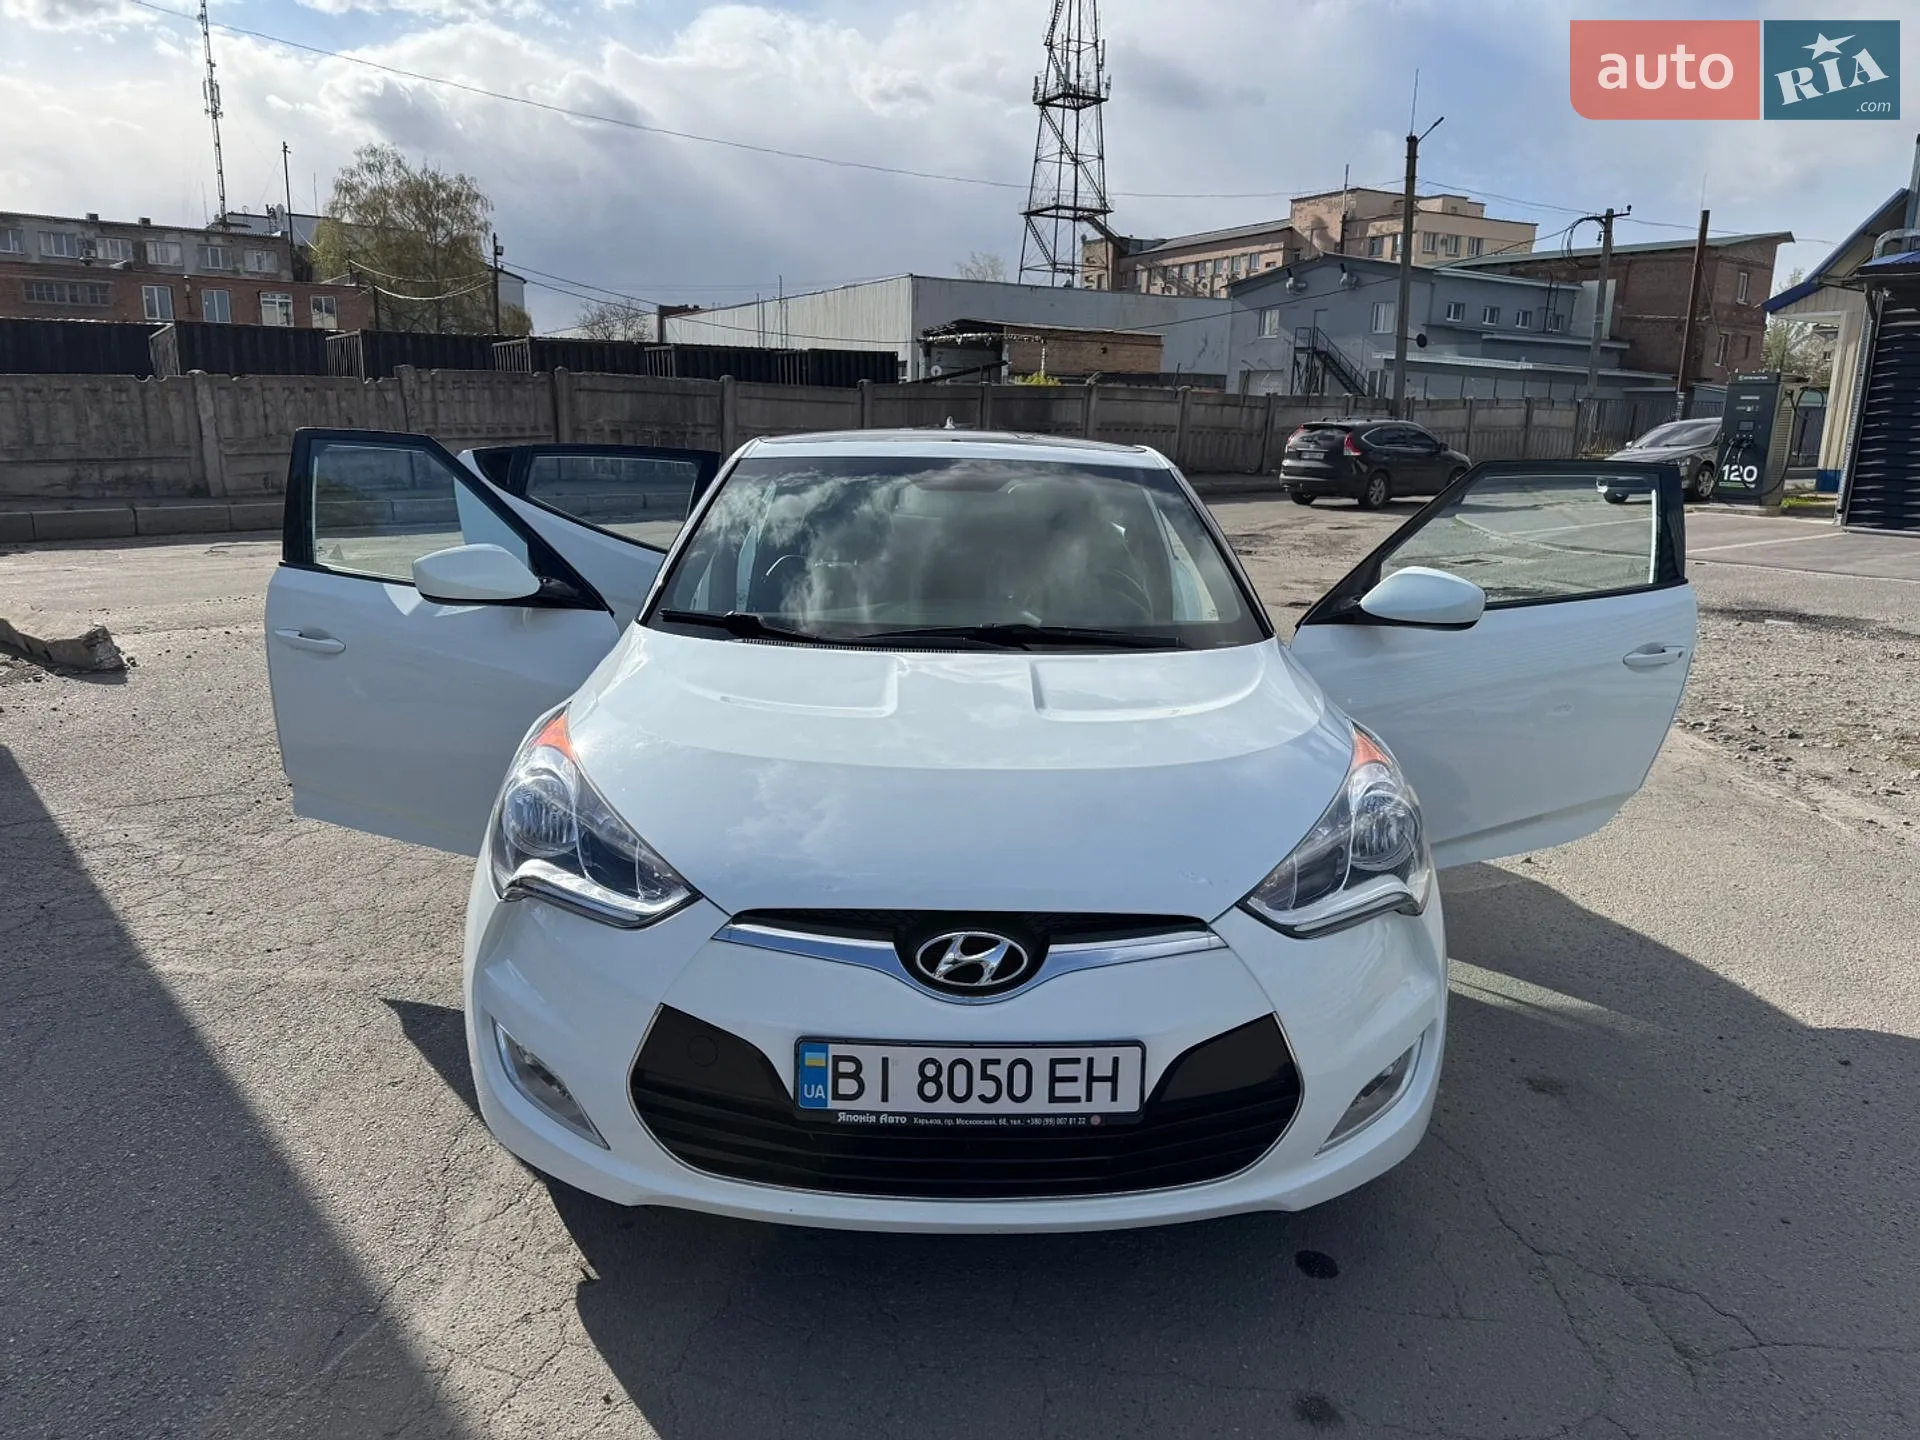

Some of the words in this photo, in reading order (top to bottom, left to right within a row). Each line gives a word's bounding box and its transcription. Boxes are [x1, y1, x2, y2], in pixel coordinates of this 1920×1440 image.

[1722, 464, 1758, 482] 120
[831, 1054, 889, 1103] BI
[917, 1057, 1034, 1104] 8050
[1048, 1056, 1120, 1104] EH
[804, 1085, 826, 1100] UA
[837, 1112, 876, 1123] Японія
[880, 1113, 907, 1124] Авто
